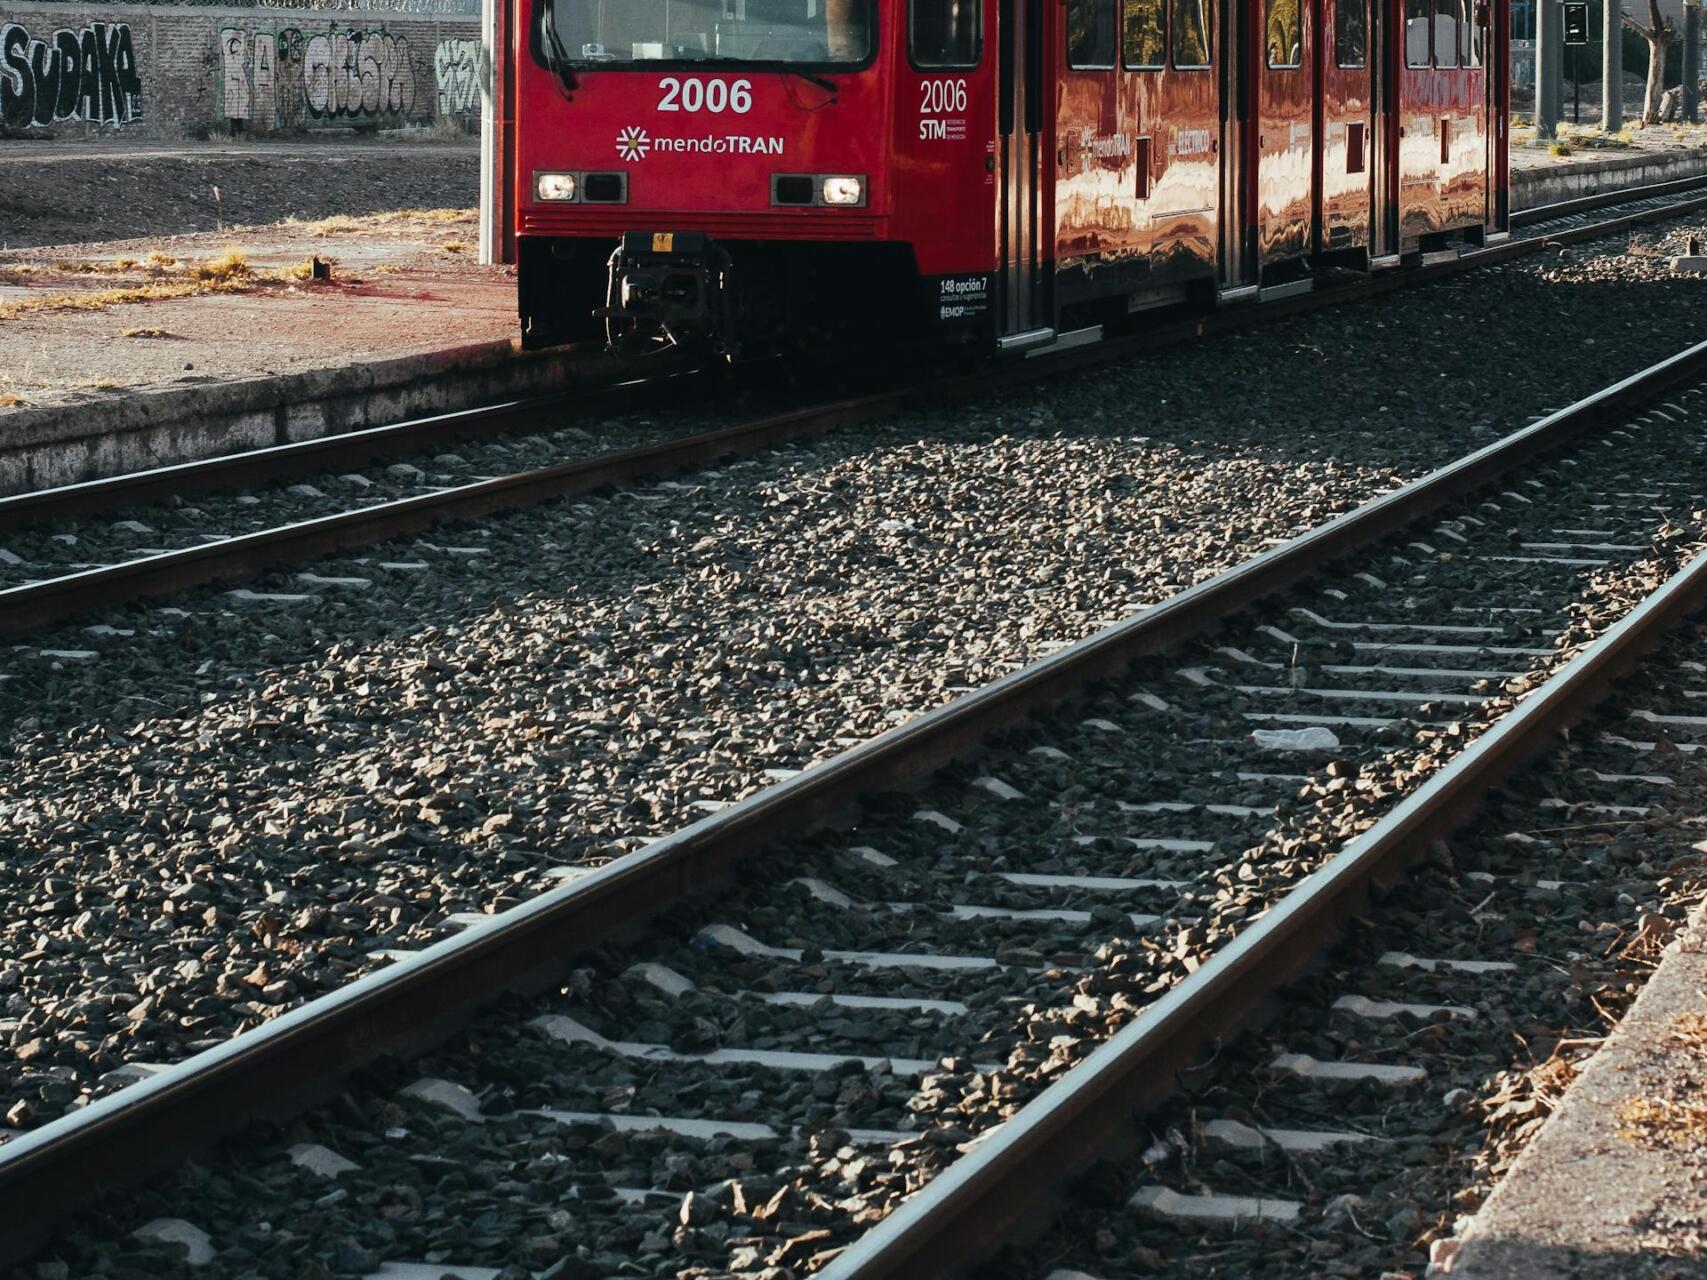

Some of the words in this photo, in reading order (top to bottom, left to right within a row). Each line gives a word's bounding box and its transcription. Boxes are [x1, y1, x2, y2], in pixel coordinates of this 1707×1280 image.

[0, 21, 142, 130] SUDAKA
[657, 77, 752, 114] 2006
[920, 79, 967, 113] 2006
[919, 119, 946, 140] STM
[654, 135, 784, 155] mendoTRAN
[940, 280, 955, 294] 148
[955, 278, 981, 295] opción
[981, 277, 987, 291] 7
